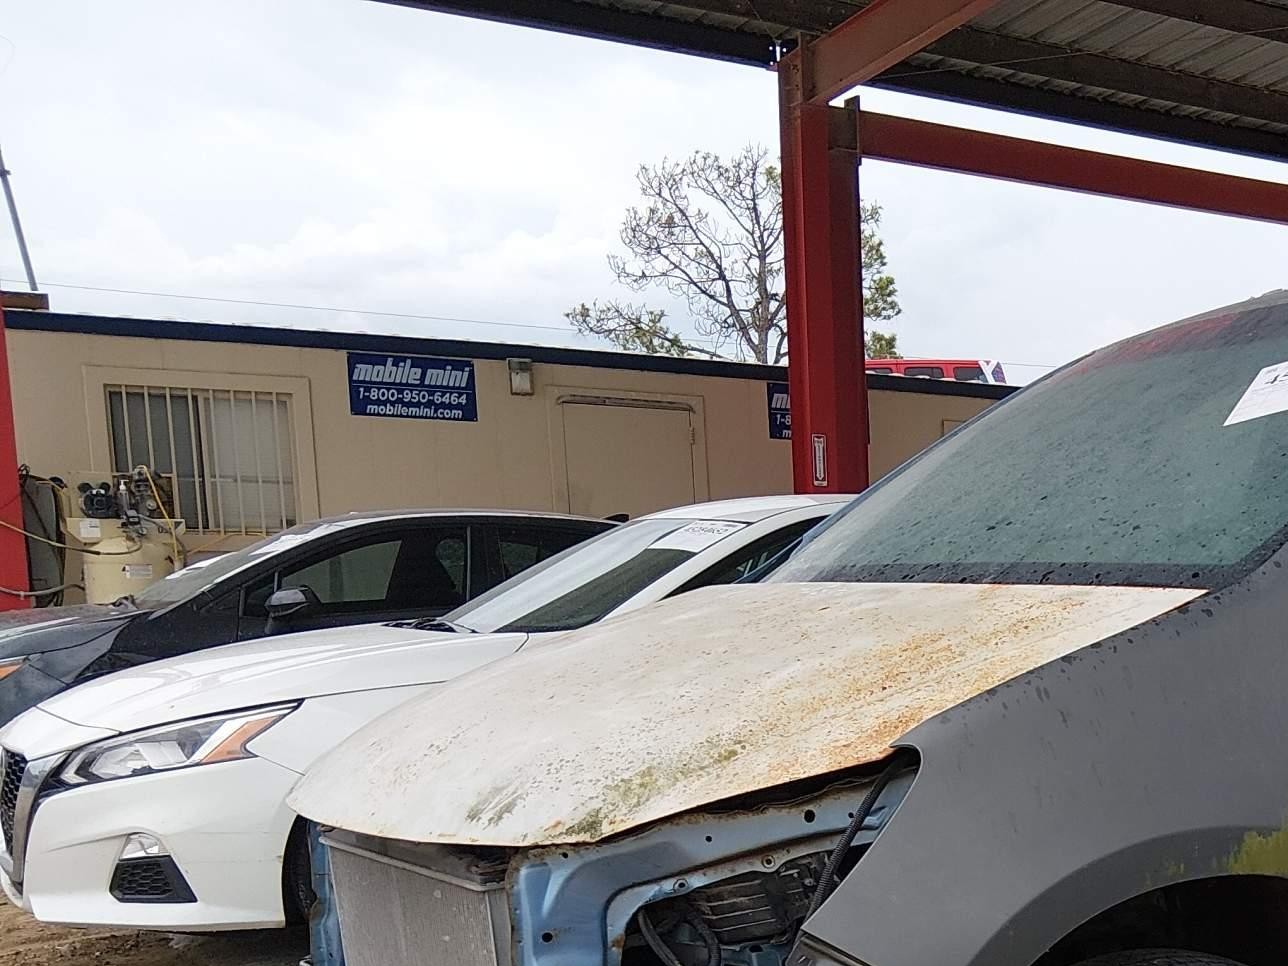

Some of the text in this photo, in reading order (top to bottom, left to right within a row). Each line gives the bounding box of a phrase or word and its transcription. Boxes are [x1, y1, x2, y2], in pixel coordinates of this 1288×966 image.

[352, 357, 470, 387] mobile mini
[358, 387, 467, 406] 1-800-950-6464
[366, 402, 463, 419] mobilemini.com
